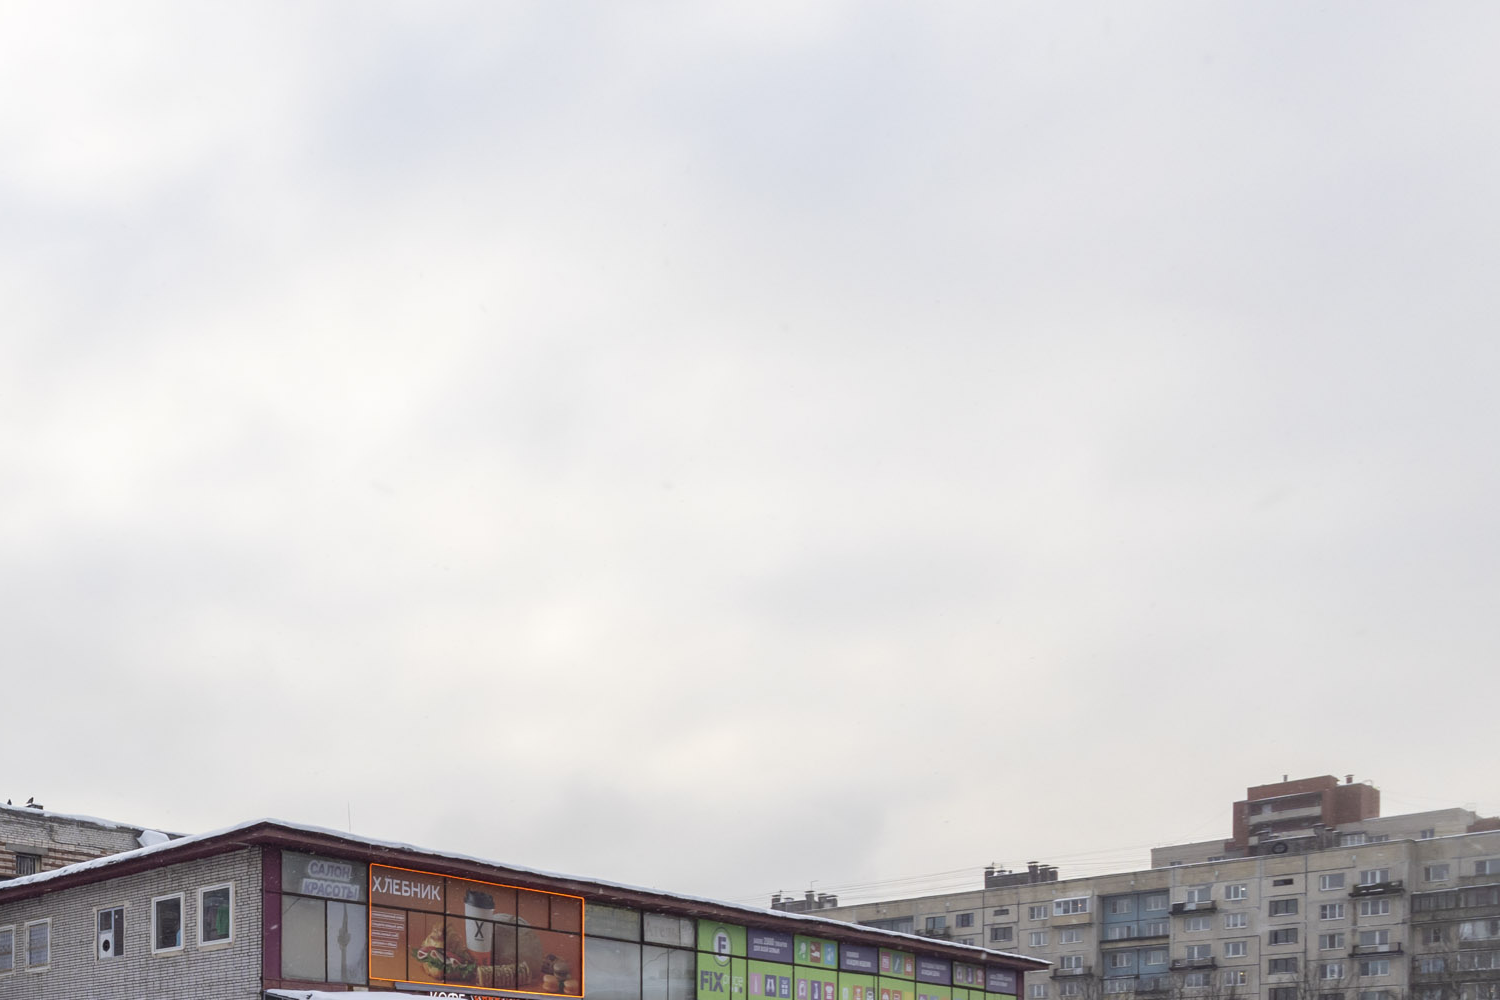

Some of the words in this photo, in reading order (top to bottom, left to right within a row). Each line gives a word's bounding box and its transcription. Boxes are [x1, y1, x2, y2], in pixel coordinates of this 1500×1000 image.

[309, 861, 351, 879] САЛОН
[303, 879, 359, 900] КРАСОТЫ
[372, 876, 441, 900] ХЛЕБНИК
